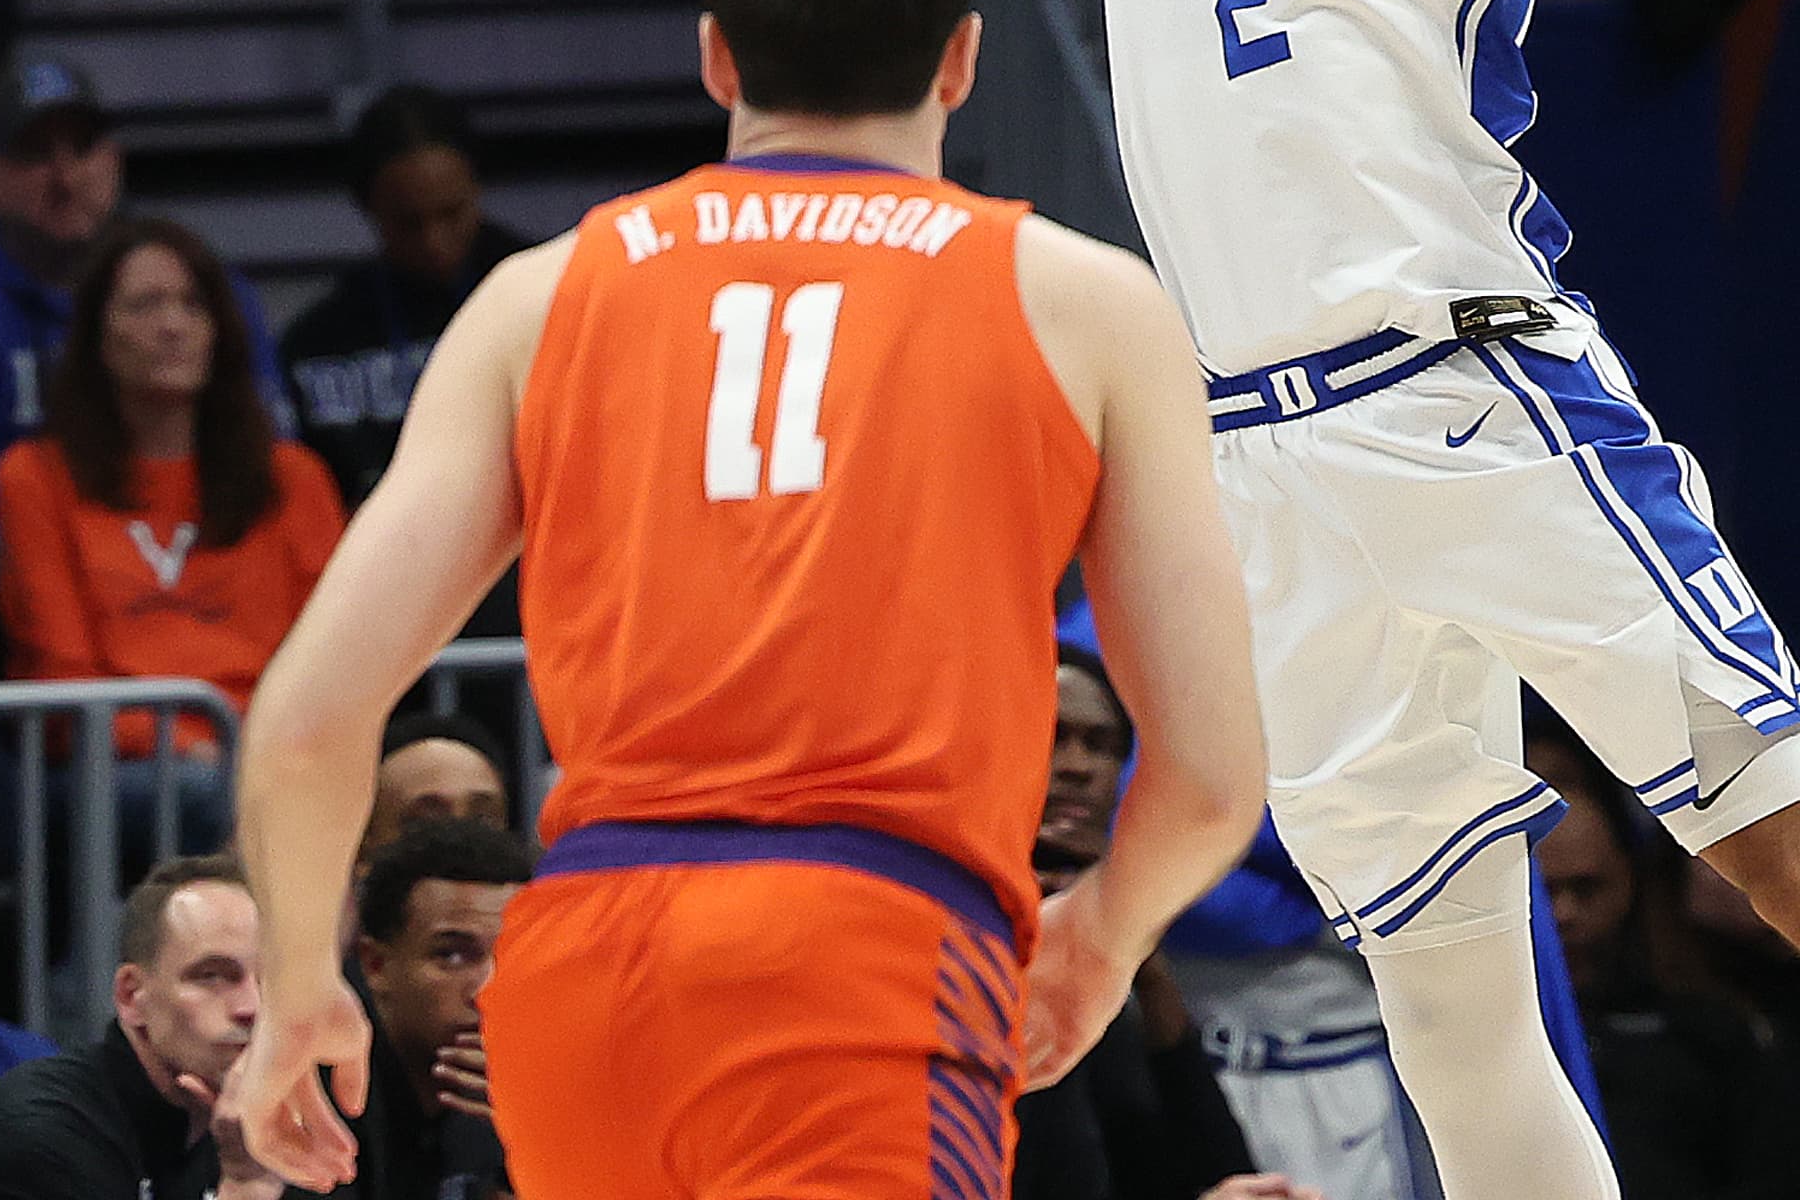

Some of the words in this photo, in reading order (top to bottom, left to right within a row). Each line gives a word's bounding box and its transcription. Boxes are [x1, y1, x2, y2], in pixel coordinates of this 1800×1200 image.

[613, 202, 677, 265] N.
[693, 190, 973, 259] DAVIDSON
[700, 280, 846, 504] 11
[1267, 365, 1317, 417] D
[1684, 556, 1756, 632] D
